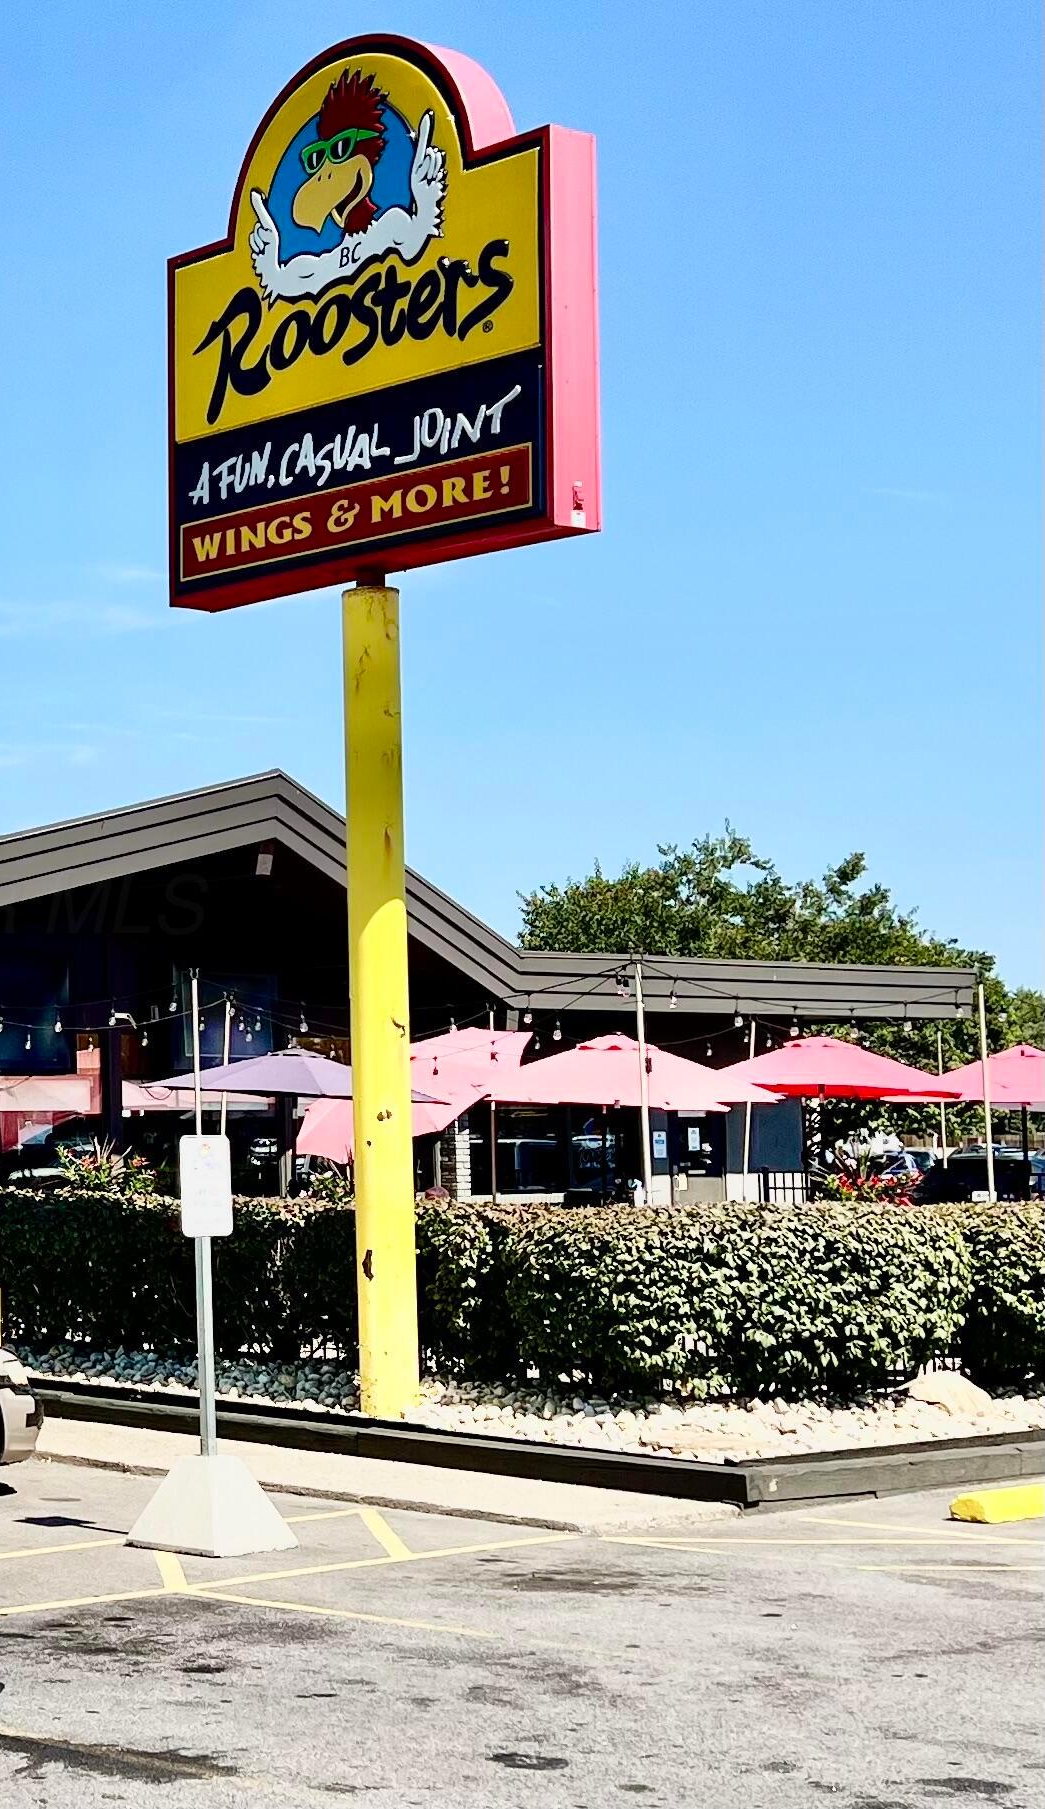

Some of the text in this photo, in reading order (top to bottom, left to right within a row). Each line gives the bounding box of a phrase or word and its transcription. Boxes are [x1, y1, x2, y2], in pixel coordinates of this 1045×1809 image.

[338, 241, 362, 268] BC
[192, 239, 514, 426] Roosters
[188, 384, 522, 505] A FUN, CASUAL JOINT
[192, 465, 511, 563] WINGS & MORE!
